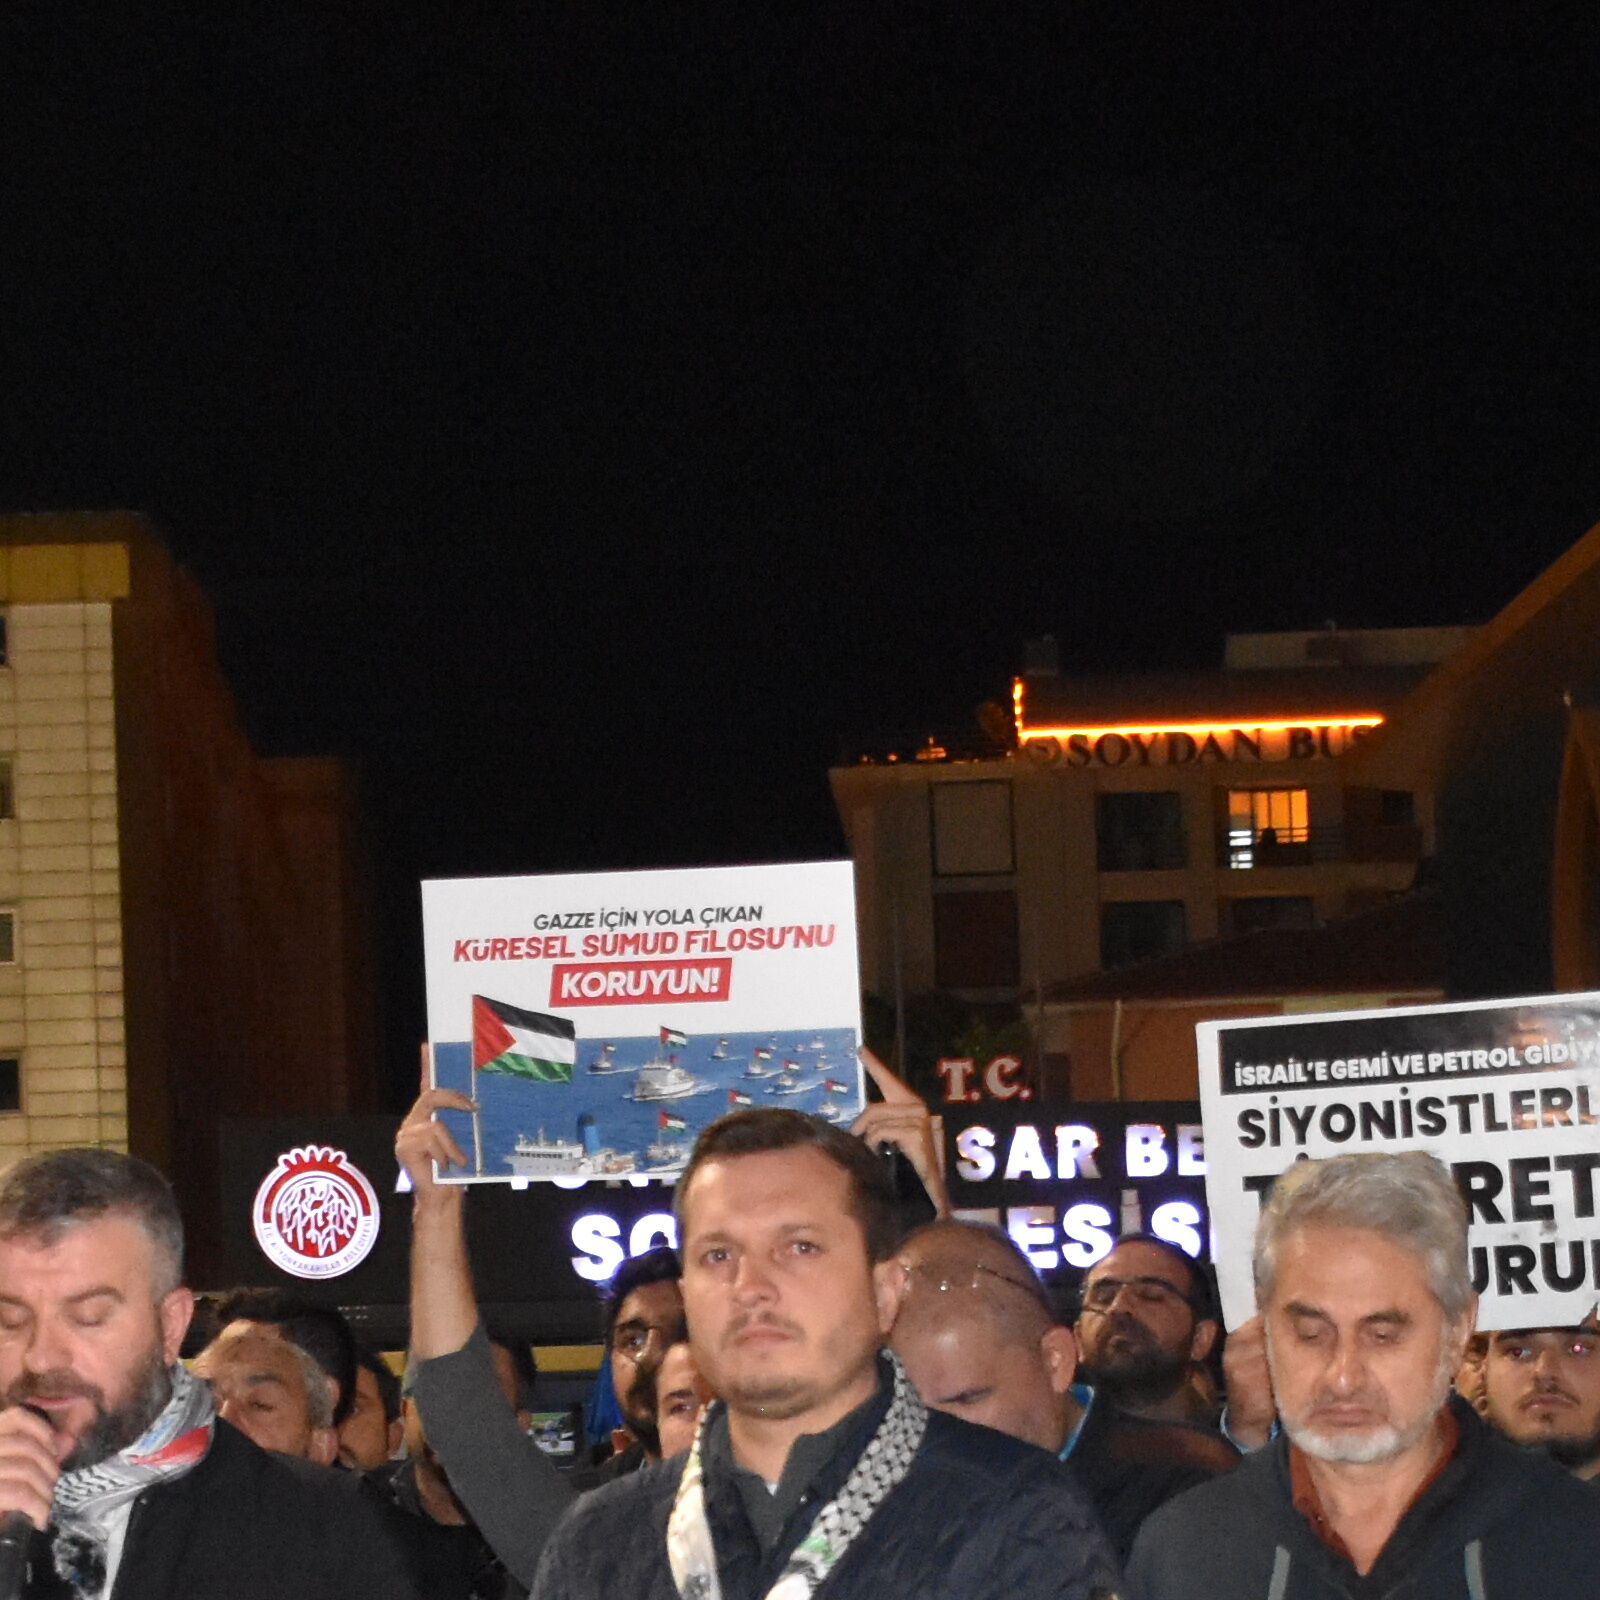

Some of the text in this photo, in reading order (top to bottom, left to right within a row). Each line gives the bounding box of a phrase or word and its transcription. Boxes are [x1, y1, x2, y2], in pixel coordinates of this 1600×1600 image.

[1067, 728, 1263, 767] SOYDAN
[533, 905, 763, 932] GAZZE İÇİN YOLA ÇIKAN
[453, 934, 576, 963] KÜRESEL
[581, 931, 679, 959] SUMUD
[560, 966, 721, 1000] KORUYUN!
[937, 1053, 1033, 1102] T.C.
[1234, 1057, 1327, 1088] İSRAİL'E
[1331, 1050, 1389, 1081] GEMİ
[1392, 1053, 1424, 1077] VE
[1428, 1045, 1520, 1075] PETROL
